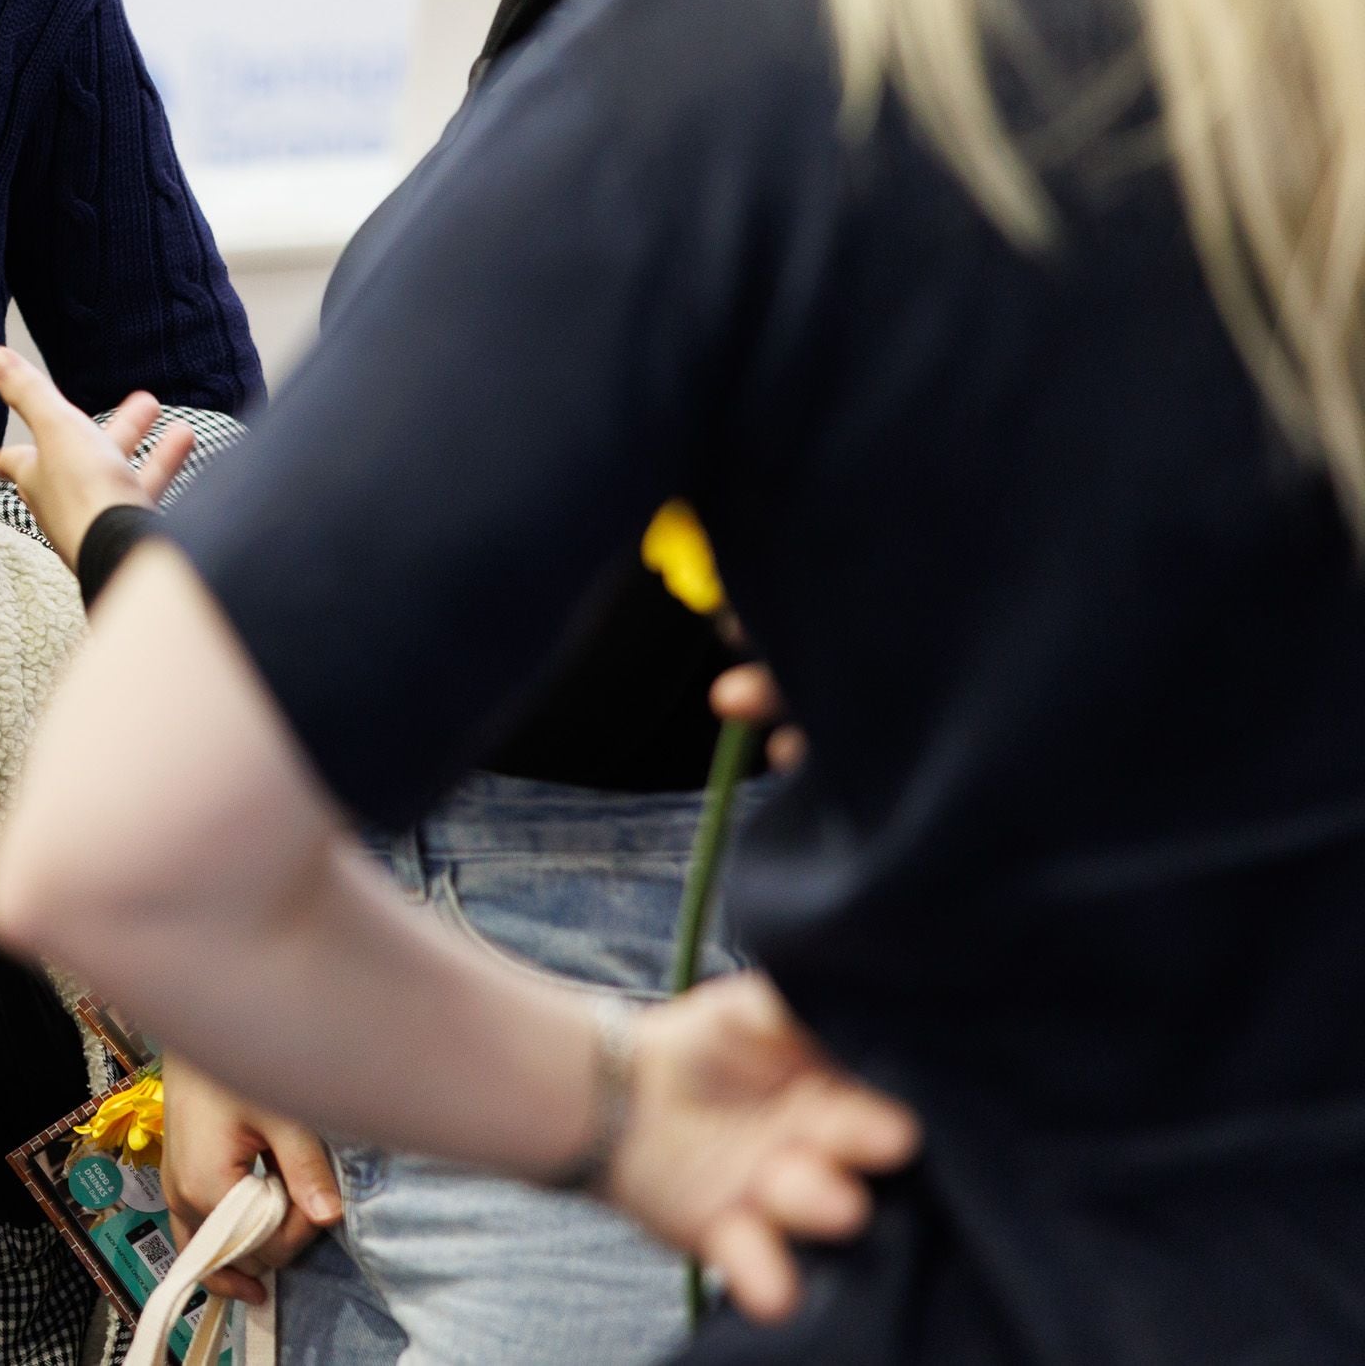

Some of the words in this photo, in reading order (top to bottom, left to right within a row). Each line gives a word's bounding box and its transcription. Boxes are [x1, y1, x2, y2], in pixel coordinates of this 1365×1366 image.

[84, 1168, 108, 1198] DRINKS
[91, 1163, 110, 1186] FOOD
[88, 1188, 101, 1205] Daily
